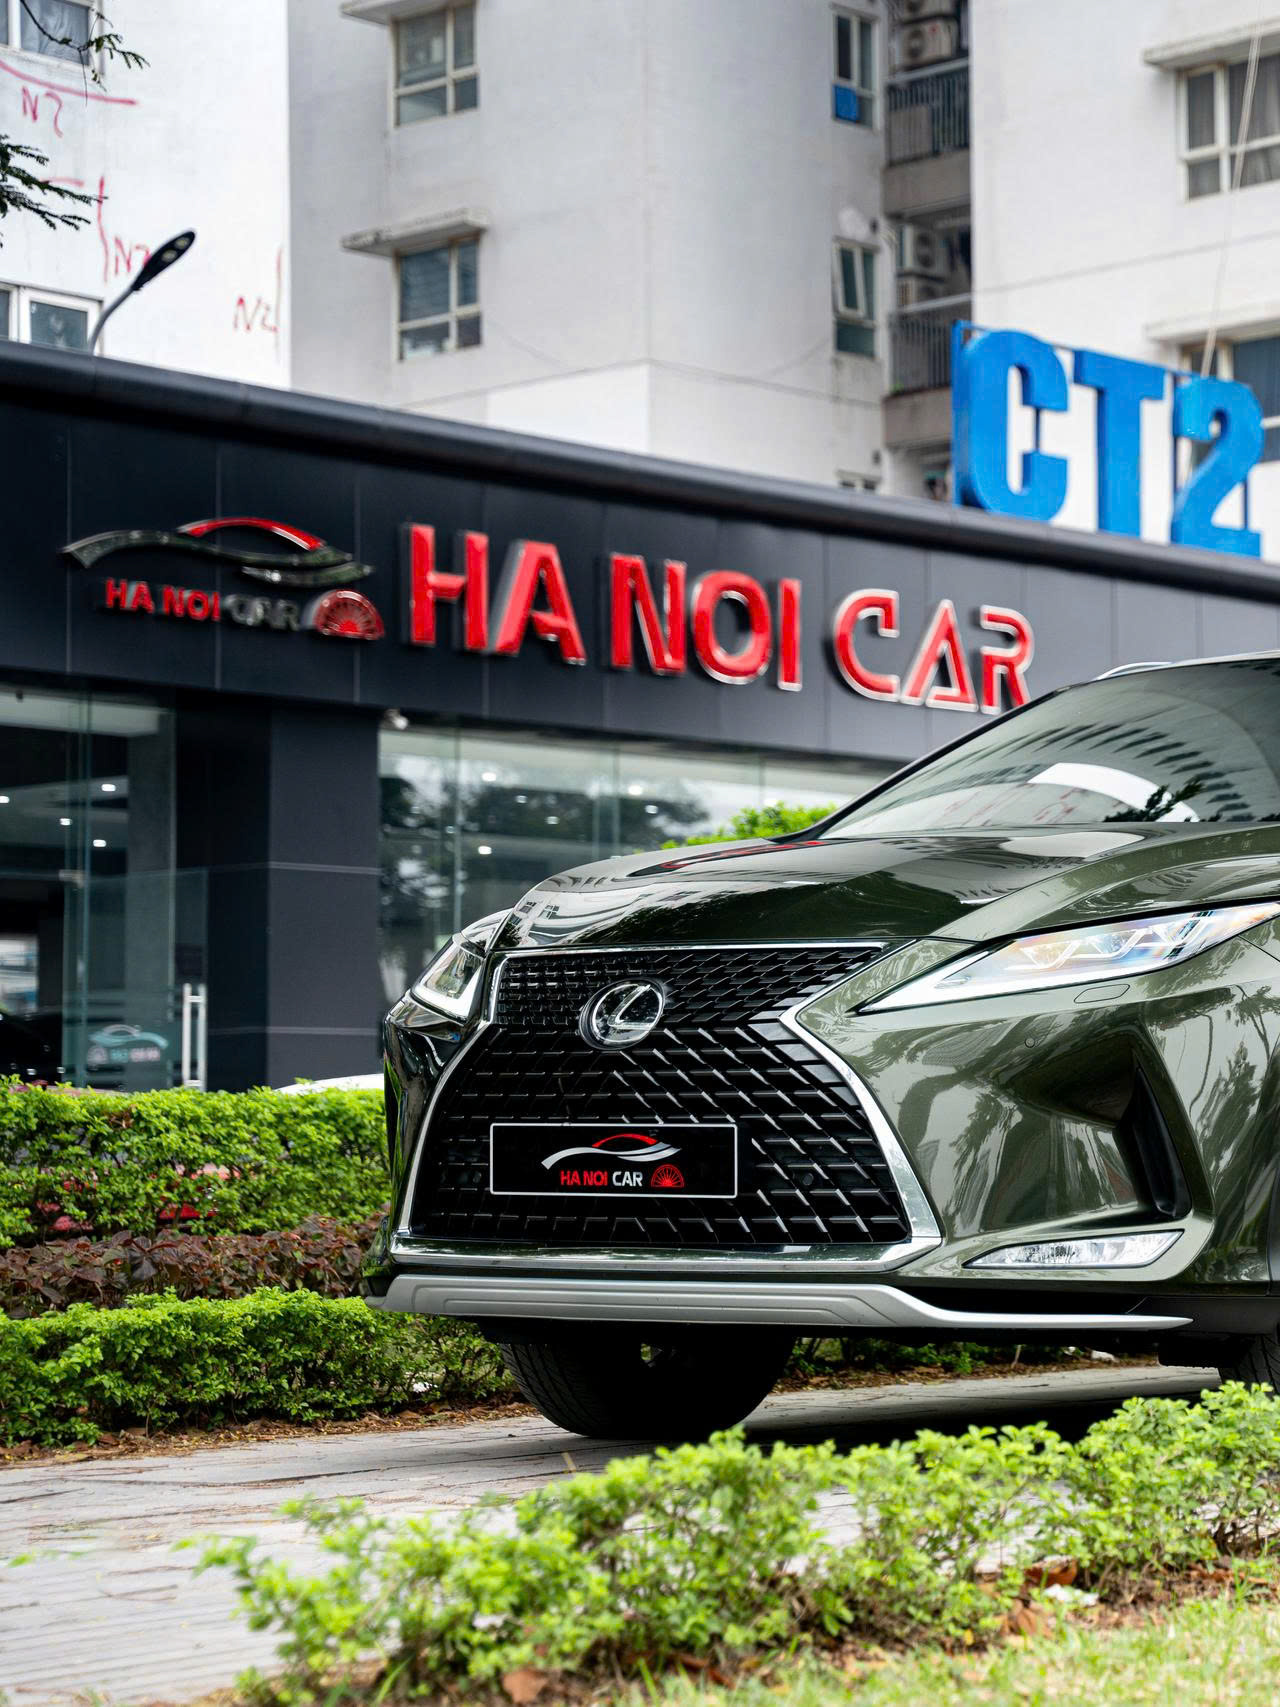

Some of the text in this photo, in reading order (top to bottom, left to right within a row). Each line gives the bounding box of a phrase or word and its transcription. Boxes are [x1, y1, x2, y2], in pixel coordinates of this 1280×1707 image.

[955, 328, 1266, 560] CT2
[105, 577, 301, 632] HA NOI CAR
[407, 521, 1035, 716] HA NOI CAR
[560, 1170, 643, 1187] HA NOI CAR
